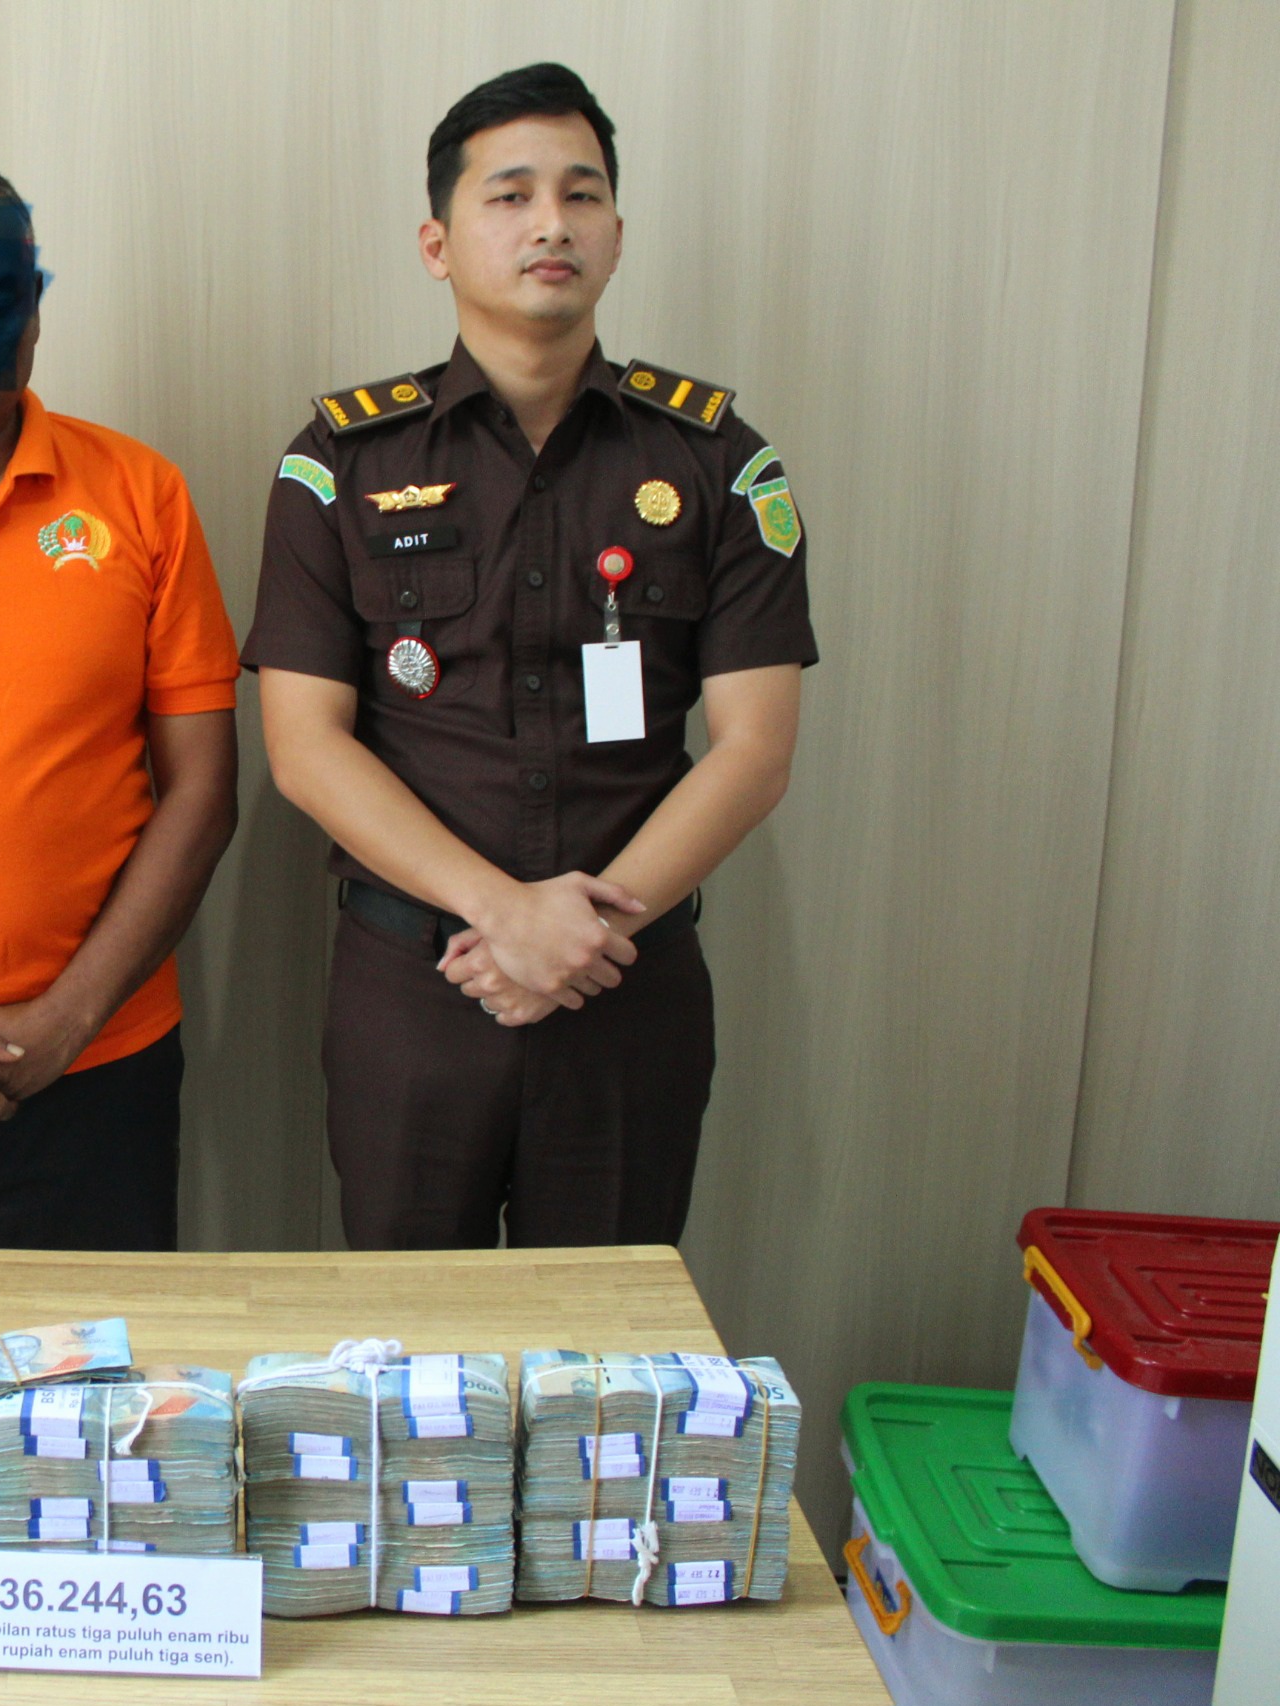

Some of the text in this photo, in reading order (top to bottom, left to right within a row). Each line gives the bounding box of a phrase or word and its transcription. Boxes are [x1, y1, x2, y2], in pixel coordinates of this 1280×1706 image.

[393, 533, 429, 550] ADIT
[35, 1625, 77, 1639] ratus
[81, 1626, 112, 1642] tiga
[116, 1628, 163, 1643] puluh
[167, 1632, 212, 1644] enam
[217, 1630, 249, 1645] ribu
[2, 1644, 54, 1660] rupiah
[58, 1647, 103, 1660] enam
[108, 1648, 154, 1663] puluh
[158, 1649, 189, 1666] tiga
[194, 1650, 234, 1667] sen).
